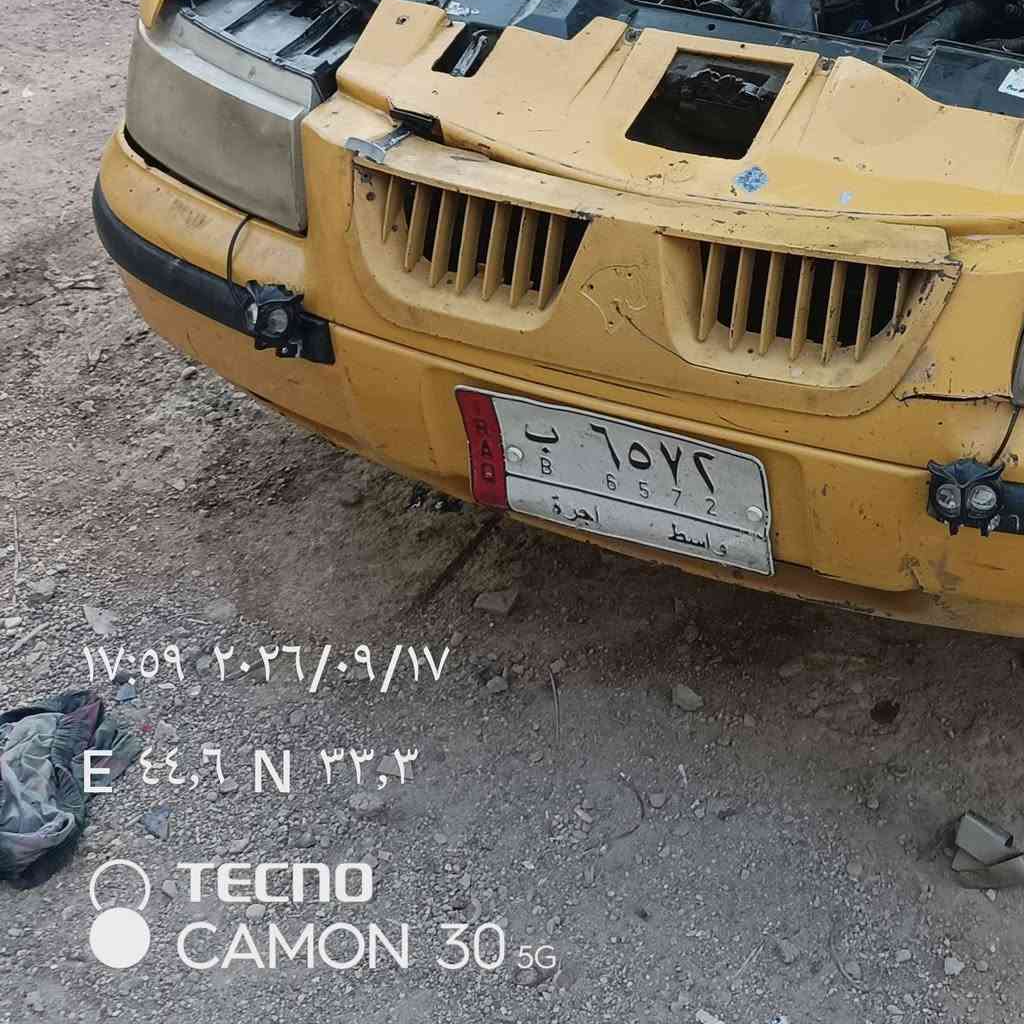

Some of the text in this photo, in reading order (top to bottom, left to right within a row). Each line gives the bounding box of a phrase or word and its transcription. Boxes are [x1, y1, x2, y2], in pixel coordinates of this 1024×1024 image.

[524, 422, 716, 495] ٦٥٧٢ ب
[540, 457, 718, 517] B 6572
[667, 522, 728, 557] واسط
